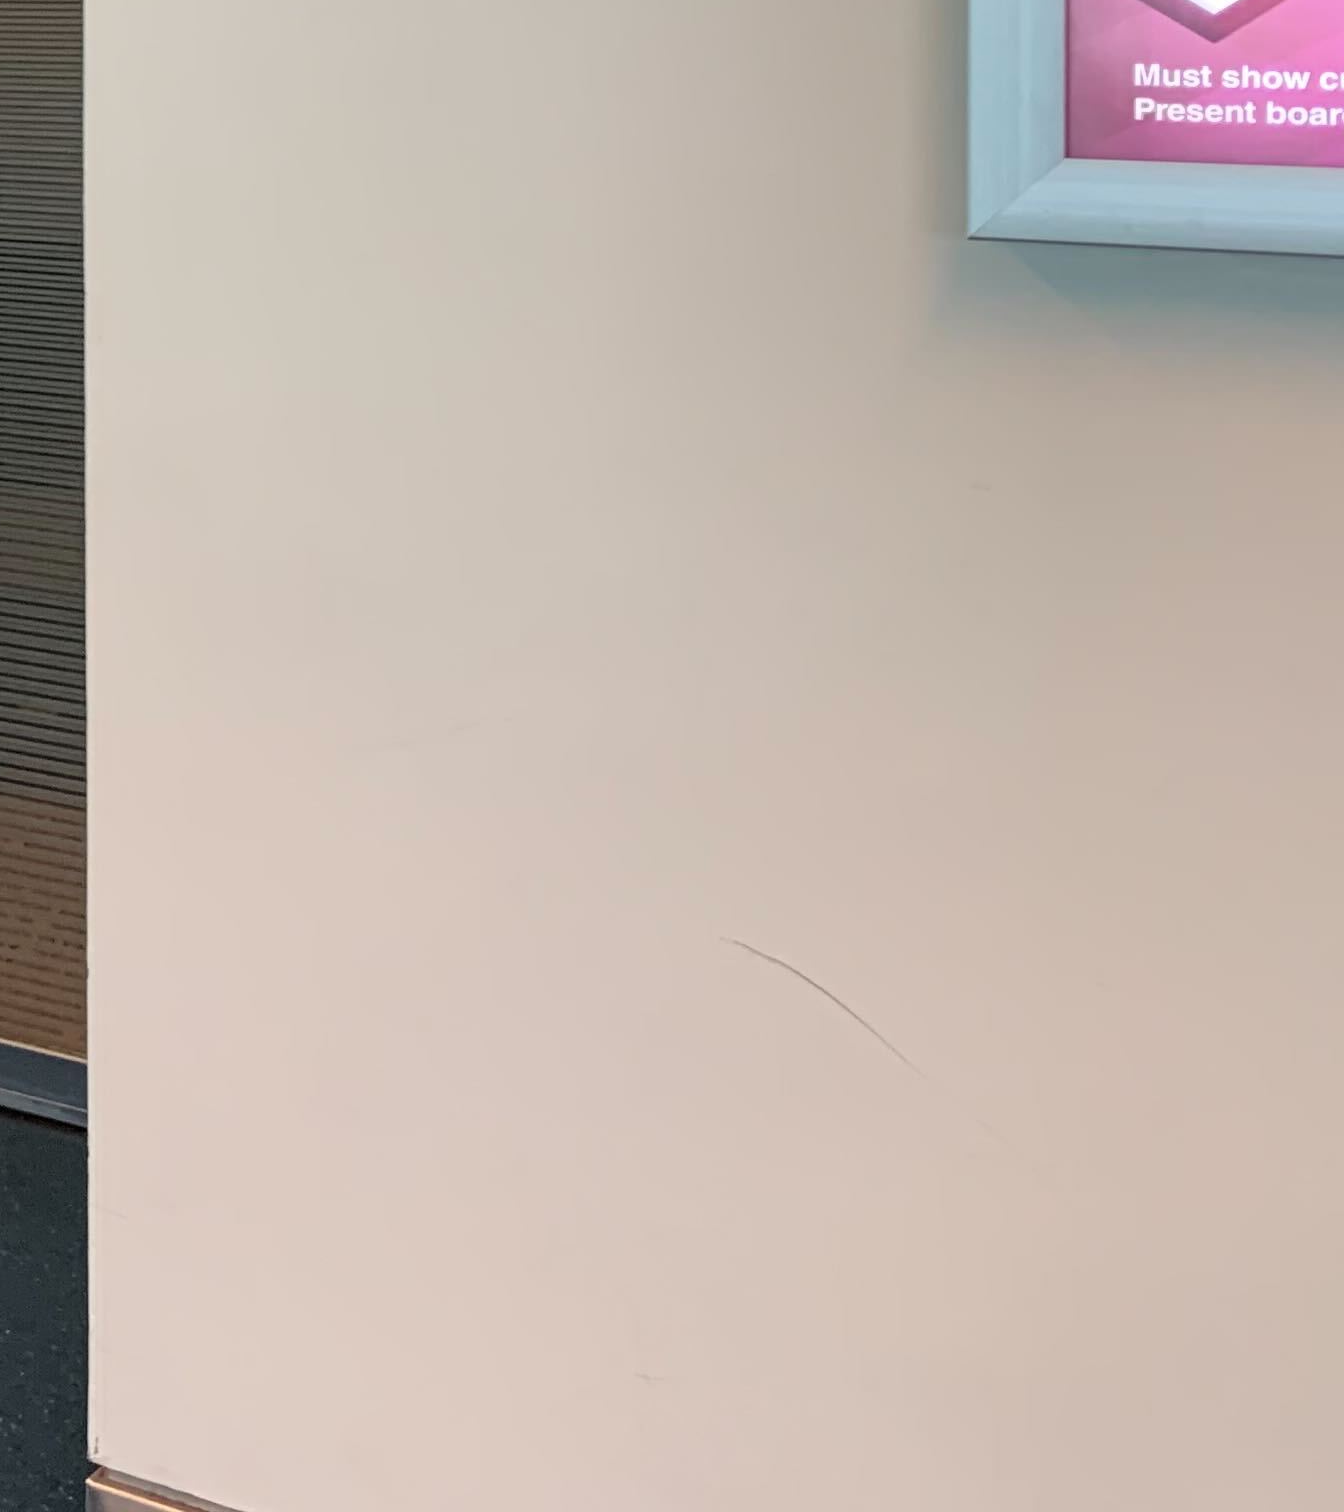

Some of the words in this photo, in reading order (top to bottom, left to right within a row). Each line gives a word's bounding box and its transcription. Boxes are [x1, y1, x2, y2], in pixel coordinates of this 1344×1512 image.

[1134, 63, 1212, 88] Must
[1222, 65, 1311, 90] show
[1134, 97, 1256, 124] Present
